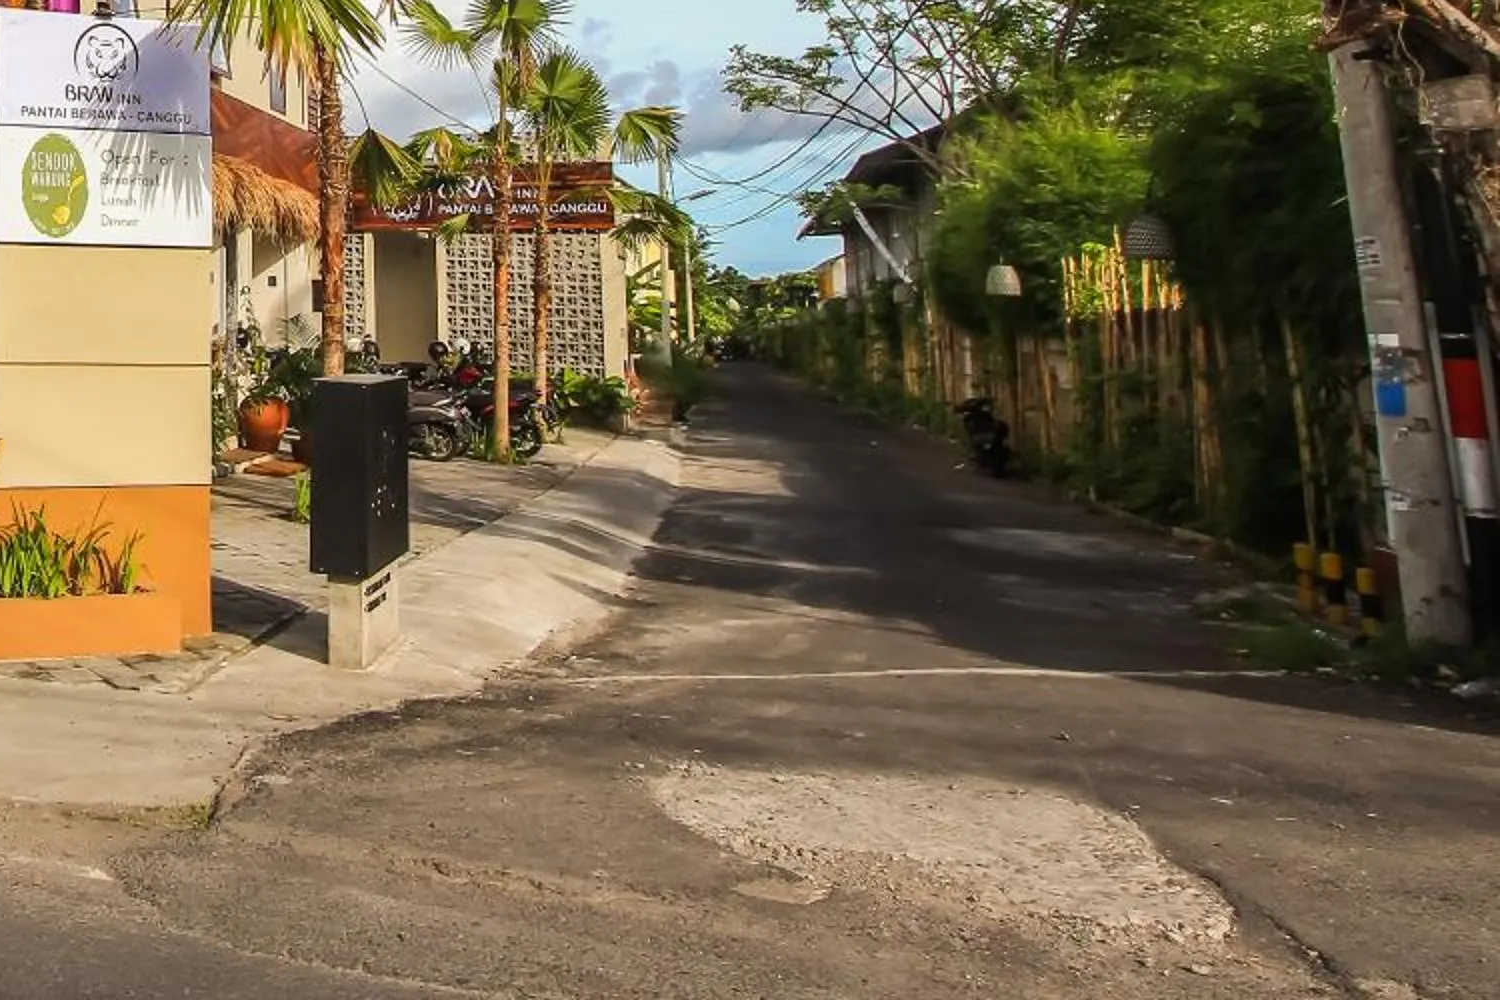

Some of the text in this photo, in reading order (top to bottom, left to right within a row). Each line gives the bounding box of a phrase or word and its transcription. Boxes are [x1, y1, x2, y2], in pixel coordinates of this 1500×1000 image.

[65, 84, 141, 105] BRAW INN
[21, 105, 67, 119] PANTAI
[71, 107, 125, 121] BERAWA
[137, 111, 192, 125] CANGGU
[101, 150, 141, 168] Open
[150, 151, 175, 166] For
[438, 203, 481, 215] PANTAI
[549, 203, 607, 213] CANGGU
